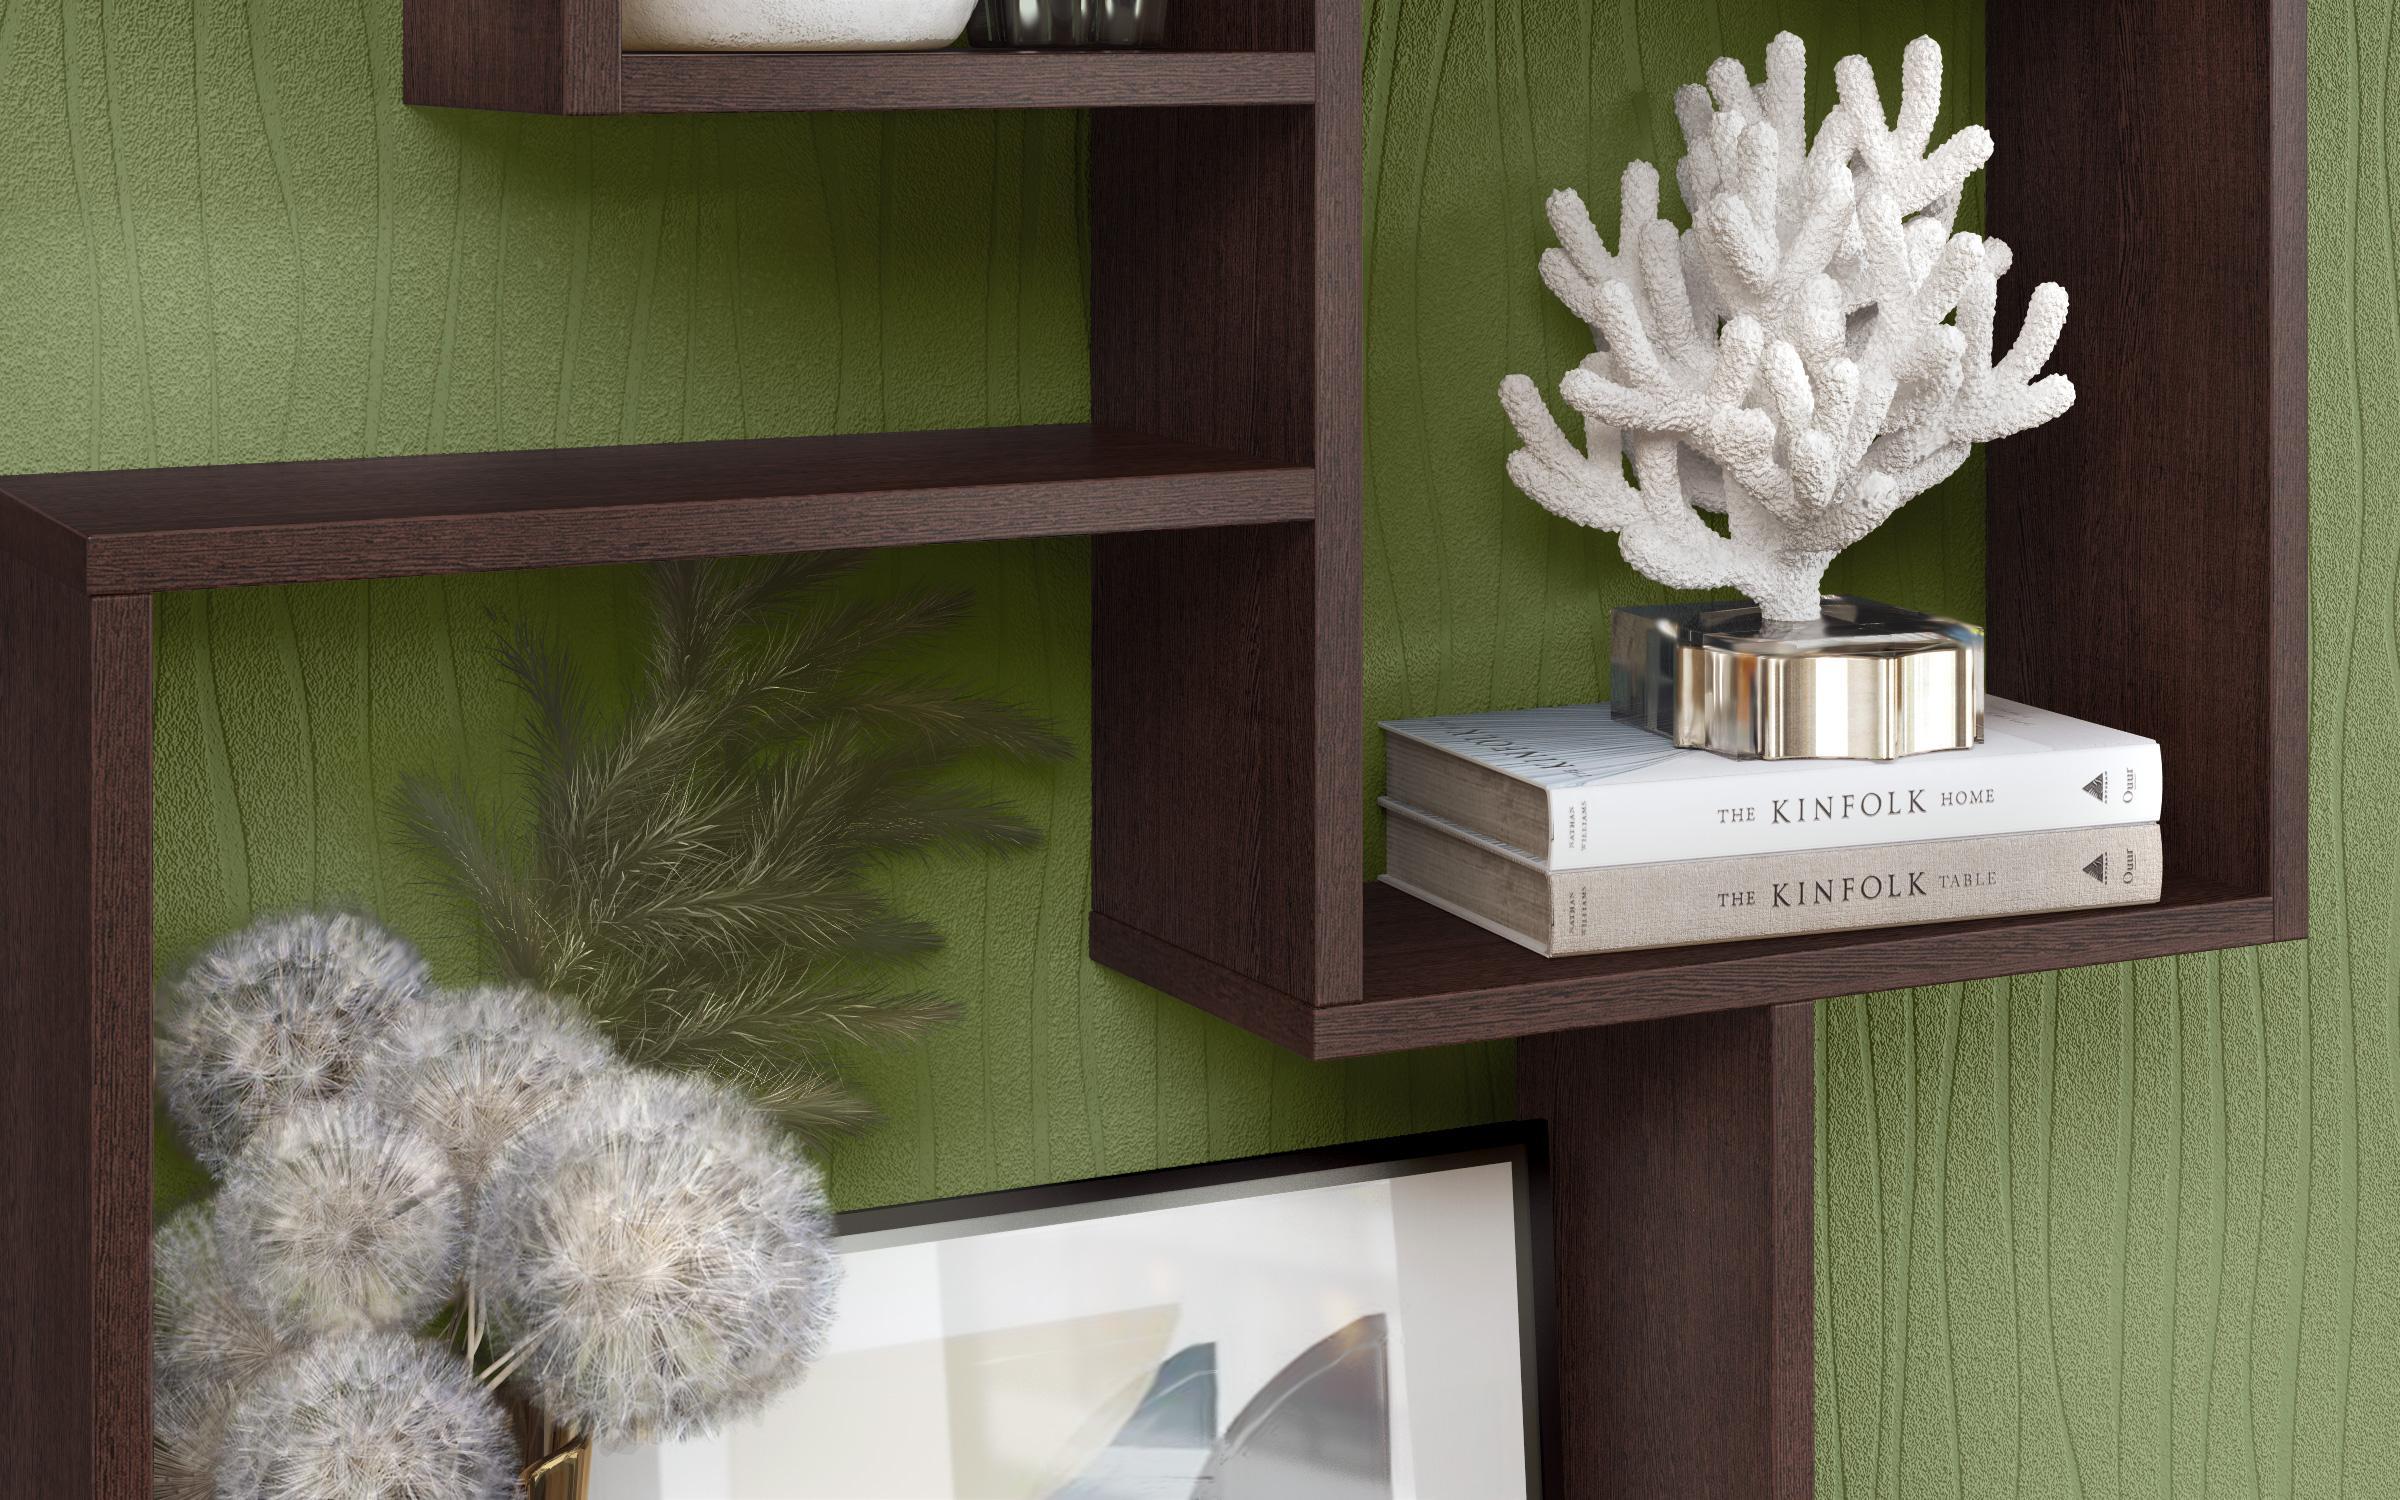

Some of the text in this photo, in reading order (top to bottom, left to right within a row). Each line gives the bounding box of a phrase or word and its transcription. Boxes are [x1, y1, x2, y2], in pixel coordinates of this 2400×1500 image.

[2122, 767, 2134, 803] Ouur
[1717, 789, 1995, 824] THE KINFOLK HOME
[2122, 848, 2134, 885] Ouur
[1717, 871, 1998, 908] THE KINFOLK TABLE
